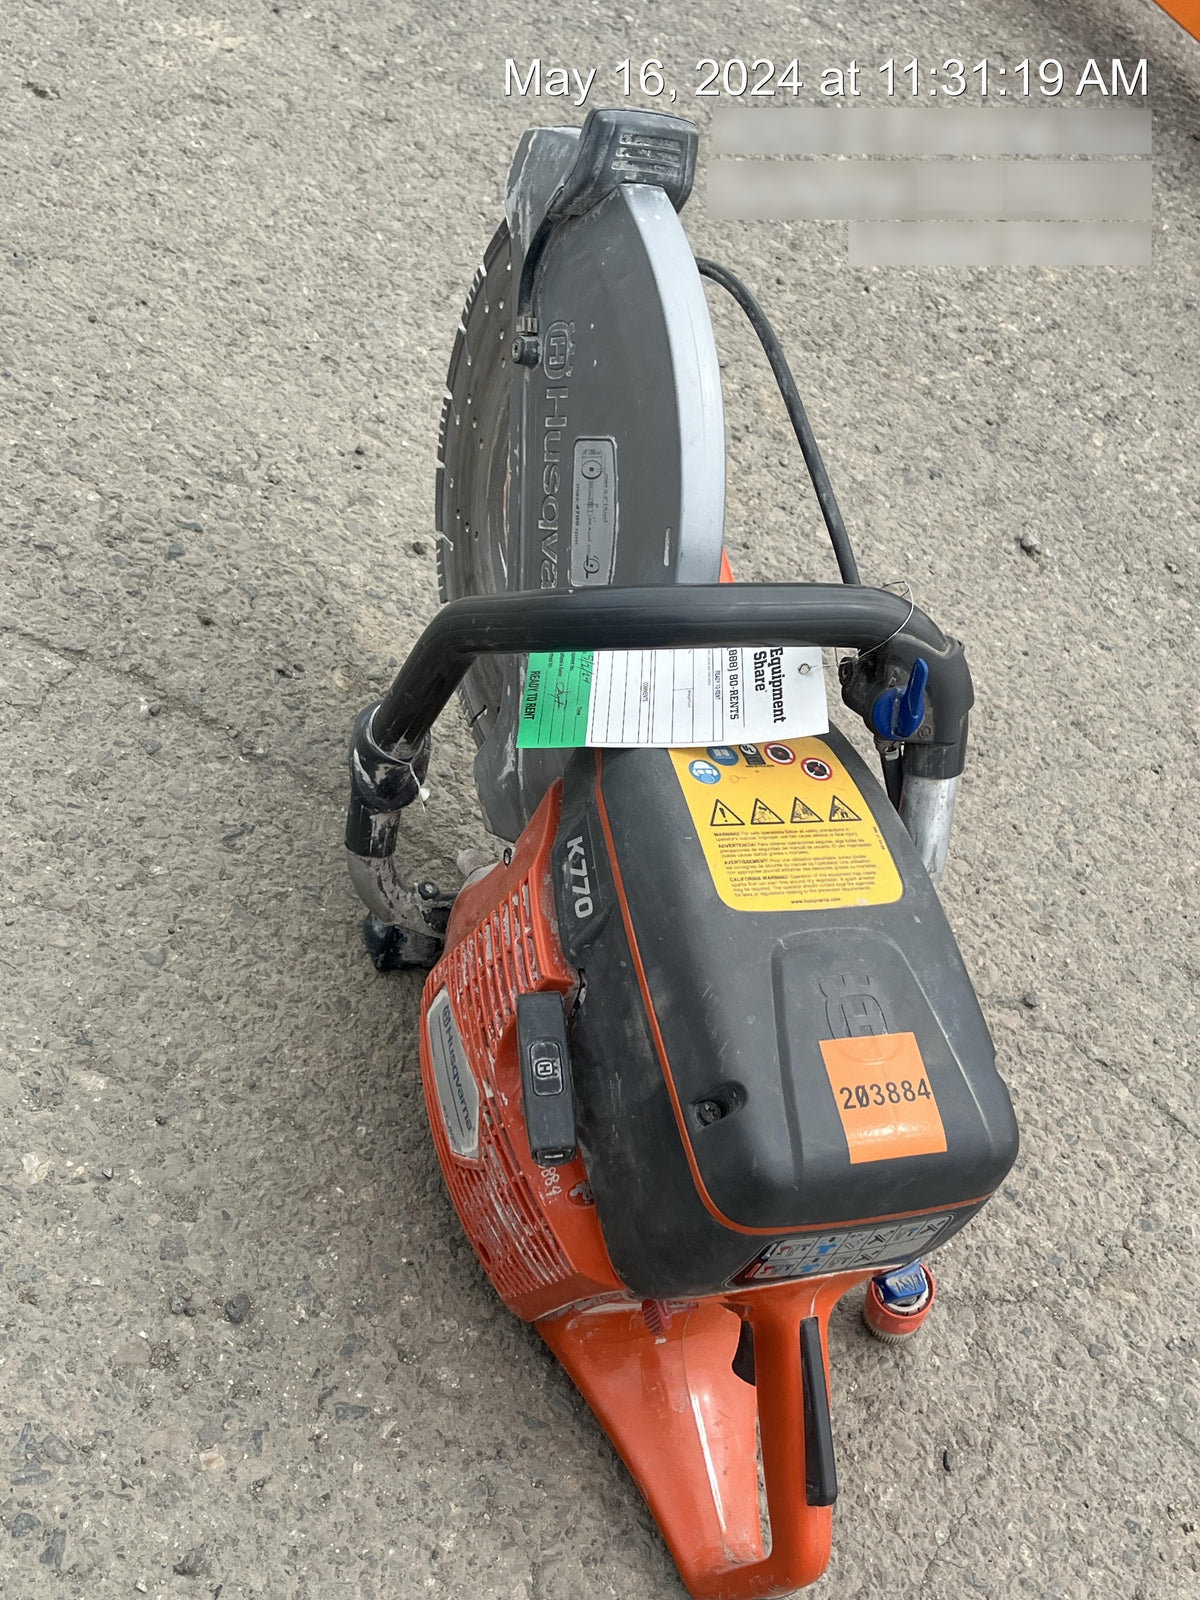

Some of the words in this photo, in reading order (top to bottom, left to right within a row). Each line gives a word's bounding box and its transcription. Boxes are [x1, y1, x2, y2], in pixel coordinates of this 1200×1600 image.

[528, 670, 540, 691] READY
[754, 651, 767, 692] Share
[768, 647, 786, 724] Equipment
[524, 703, 536, 720] RENT
[526, 693, 538, 702] TO
[729, 674, 740, 720] 80-RENTS
[566, 836, 594, 918] K770
[445, 1027, 473, 1132] Husqvarna
[839, 1077, 932, 1110] 203884
[538, 1165, 562, 1196] 884
